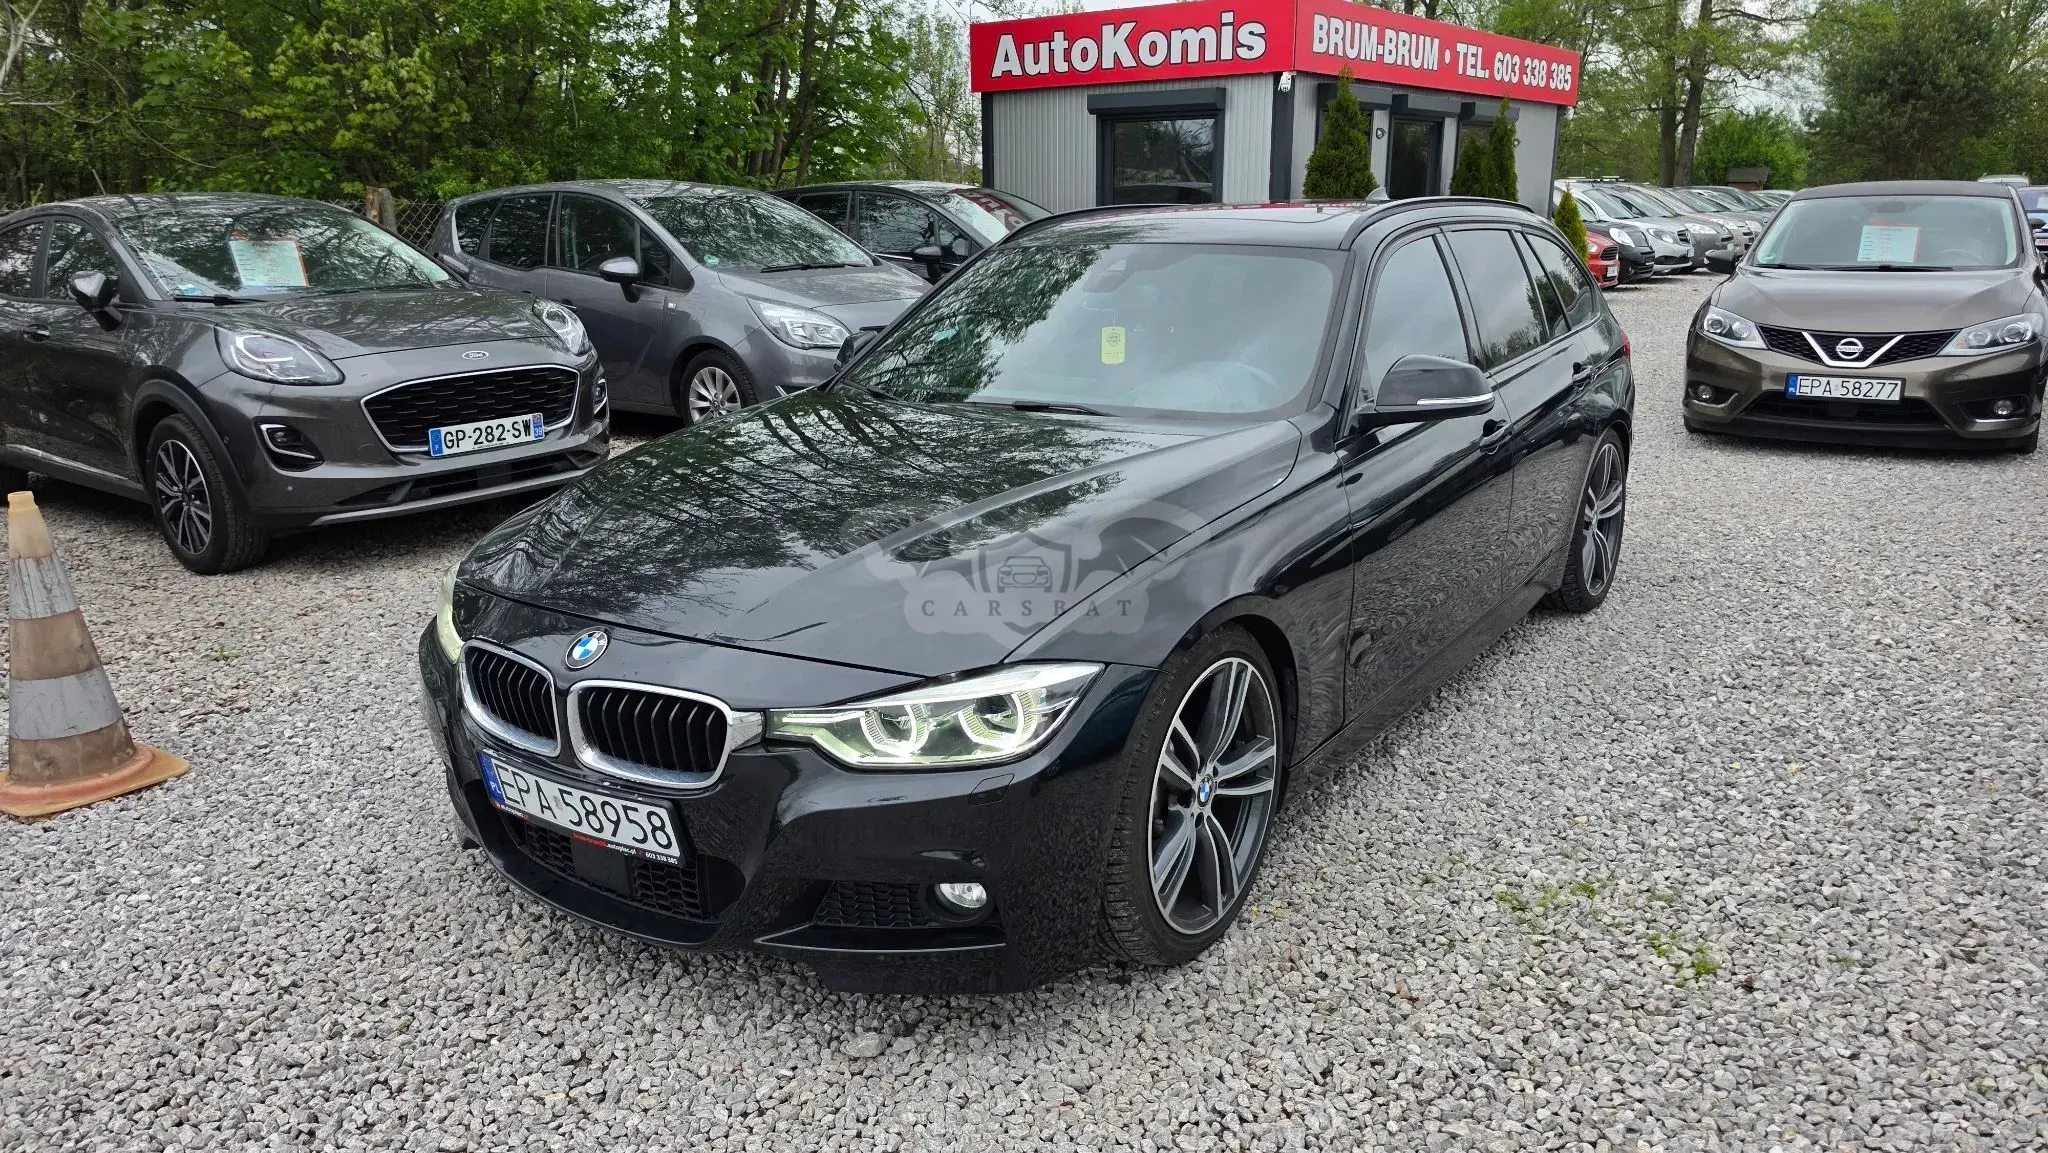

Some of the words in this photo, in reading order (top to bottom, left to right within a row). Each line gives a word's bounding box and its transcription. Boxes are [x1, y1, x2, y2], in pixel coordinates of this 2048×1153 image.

[990, 10, 1267, 78] AutoKomis
[1312, 13, 1440, 71] BRUM-BRUM
[1456, 42, 1489, 79] TEL.
[1494, 50, 1520, 84] 603
[1522, 56, 1547, 88] 338
[1550, 61, 1572, 92] 385
[1799, 378, 1832, 396] EPA
[1839, 380, 1899, 399] 58277
[443, 418, 531, 449] GP-282-SW
[489, 780, 502, 794] PL
[493, 763, 557, 820] EPA
[557, 787, 673, 850] 58958
